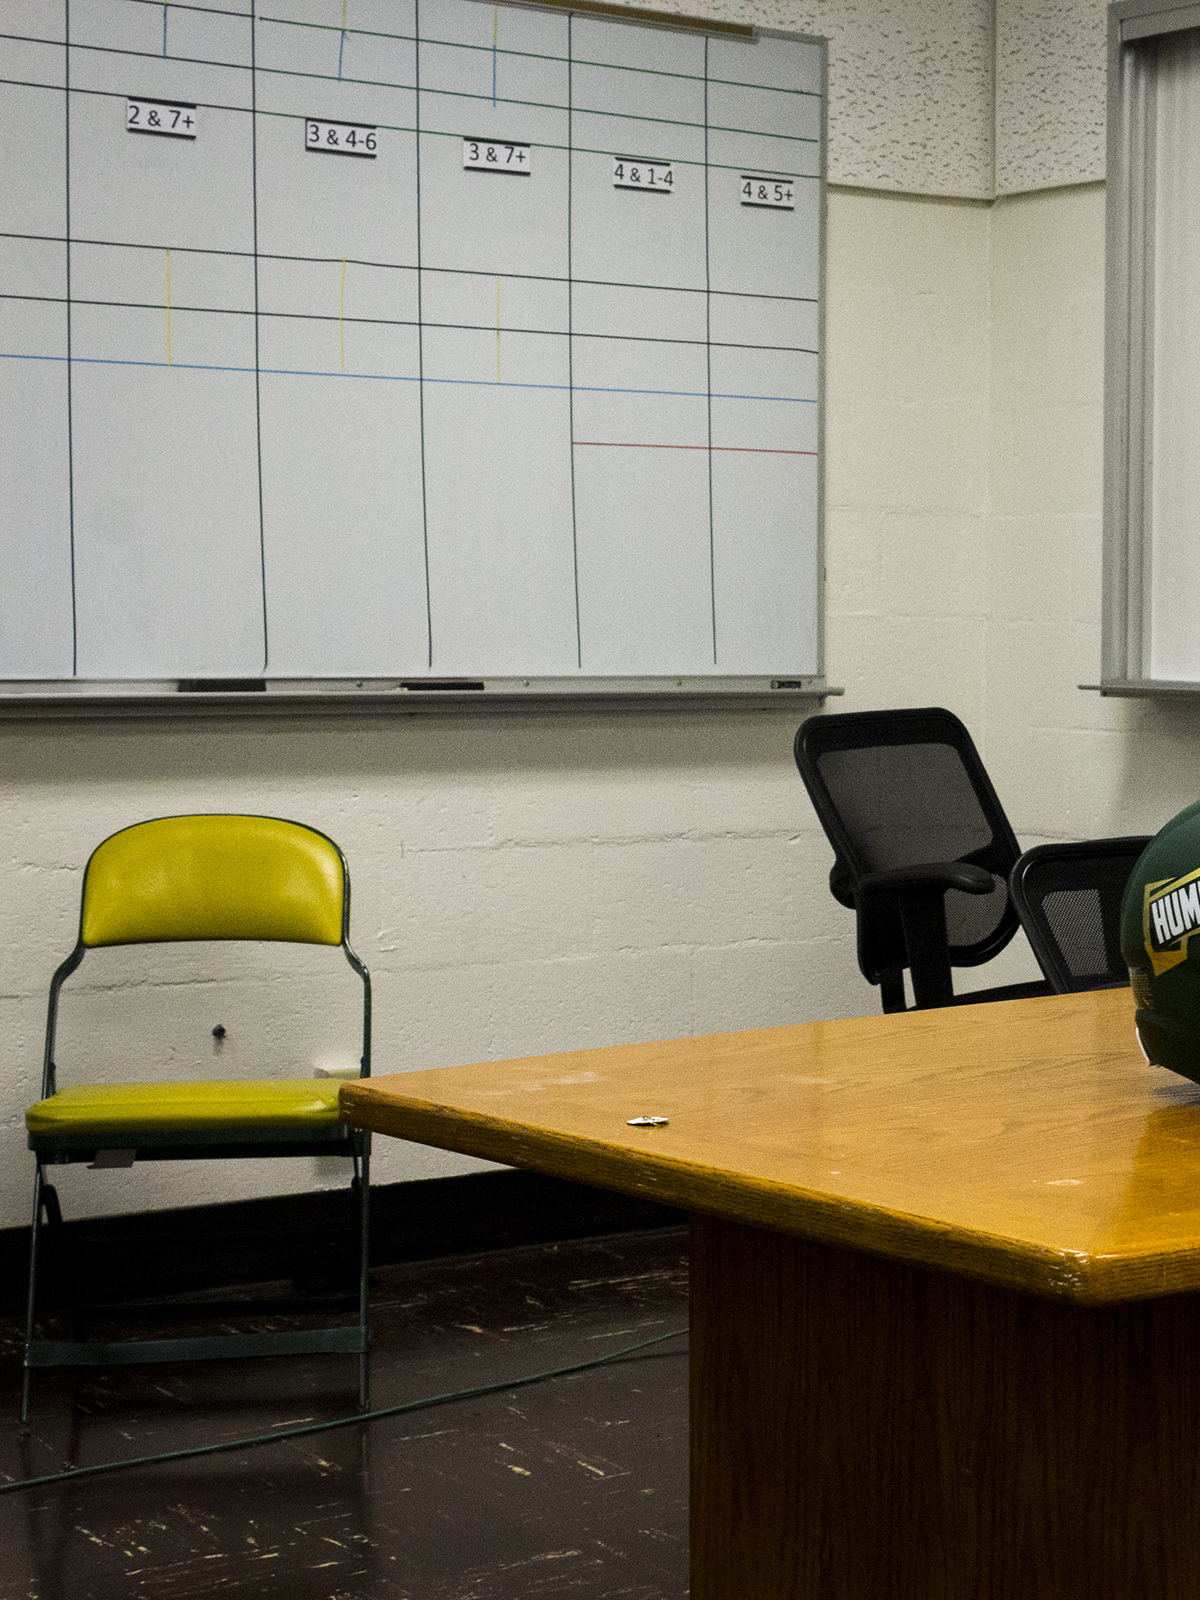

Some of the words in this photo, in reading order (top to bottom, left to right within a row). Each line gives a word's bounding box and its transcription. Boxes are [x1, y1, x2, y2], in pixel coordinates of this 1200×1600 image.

[127, 105, 141, 125] 2
[147, 110, 162, 127] &
[168, 109, 195, 129] 7+
[308, 124, 320, 143] 3
[326, 129, 340, 146] &
[345, 131, 378, 150] 4-6
[468, 143, 480, 161] 3
[486, 147, 498, 162] &
[504, 146, 526, 164] 7+
[613, 163, 625, 181] 4
[630, 168, 641, 183] &
[647, 168, 674, 187] 1-4
[742, 180, 752, 198] 4
[757, 185, 768, 200] &
[773, 184, 794, 202] 5+
